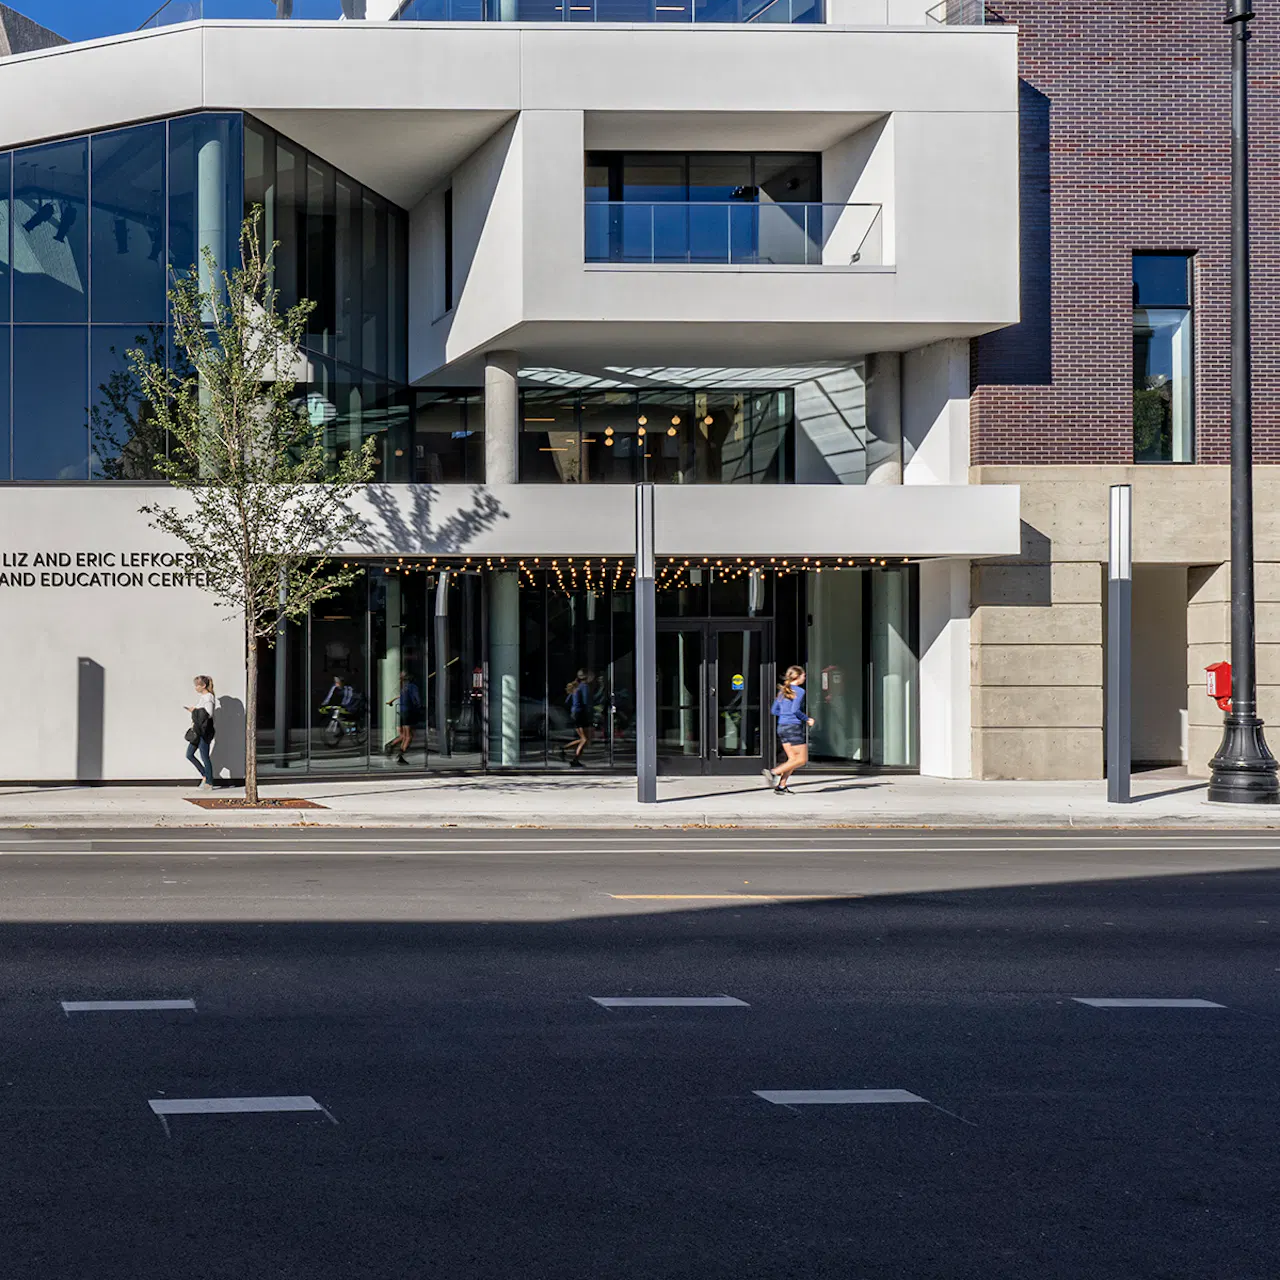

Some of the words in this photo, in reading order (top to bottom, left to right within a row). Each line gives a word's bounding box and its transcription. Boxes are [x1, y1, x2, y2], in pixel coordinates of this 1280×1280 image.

[2, 552, 28, 567] LIZ
[33, 552, 72, 567] AND
[76, 552, 116, 567] ERIC
[40, 572, 143, 587] EDUCATION
